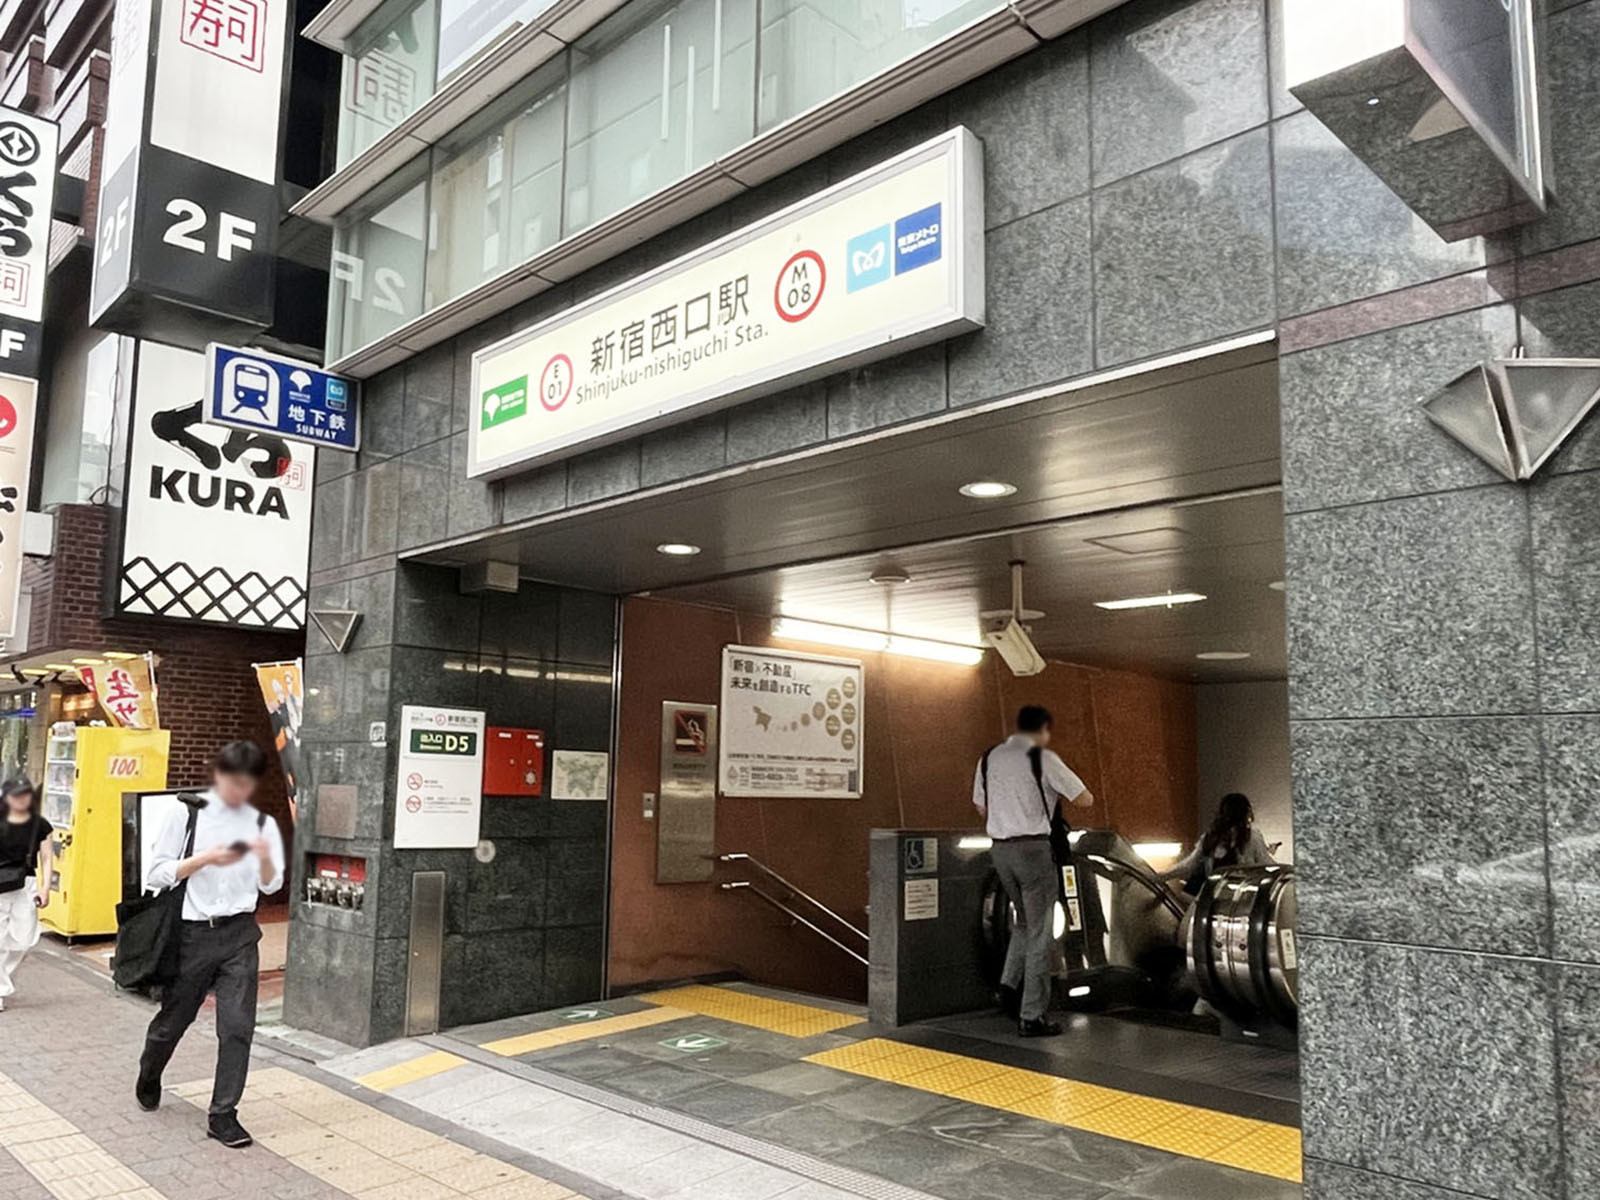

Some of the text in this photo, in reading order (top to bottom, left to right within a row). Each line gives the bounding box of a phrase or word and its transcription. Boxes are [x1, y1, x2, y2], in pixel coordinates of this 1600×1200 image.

[101, 196, 129, 267] 2F
[163, 199, 256, 261] 2F
[792, 263, 809, 284] M
[787, 283, 812, 308] 08
[590, 274, 749, 376] 新宿西口駅
[554, 363, 560, 379] E
[576, 323, 769, 405] Shinjuku-nishiguchi Sta.
[548, 380, 562, 400] 01
[288, 404, 346, 431] 地下鉄
[296, 424, 338, 440] SUBWAY
[149, 466, 290, 520] KURA
[445, 735, 469, 752] D5
